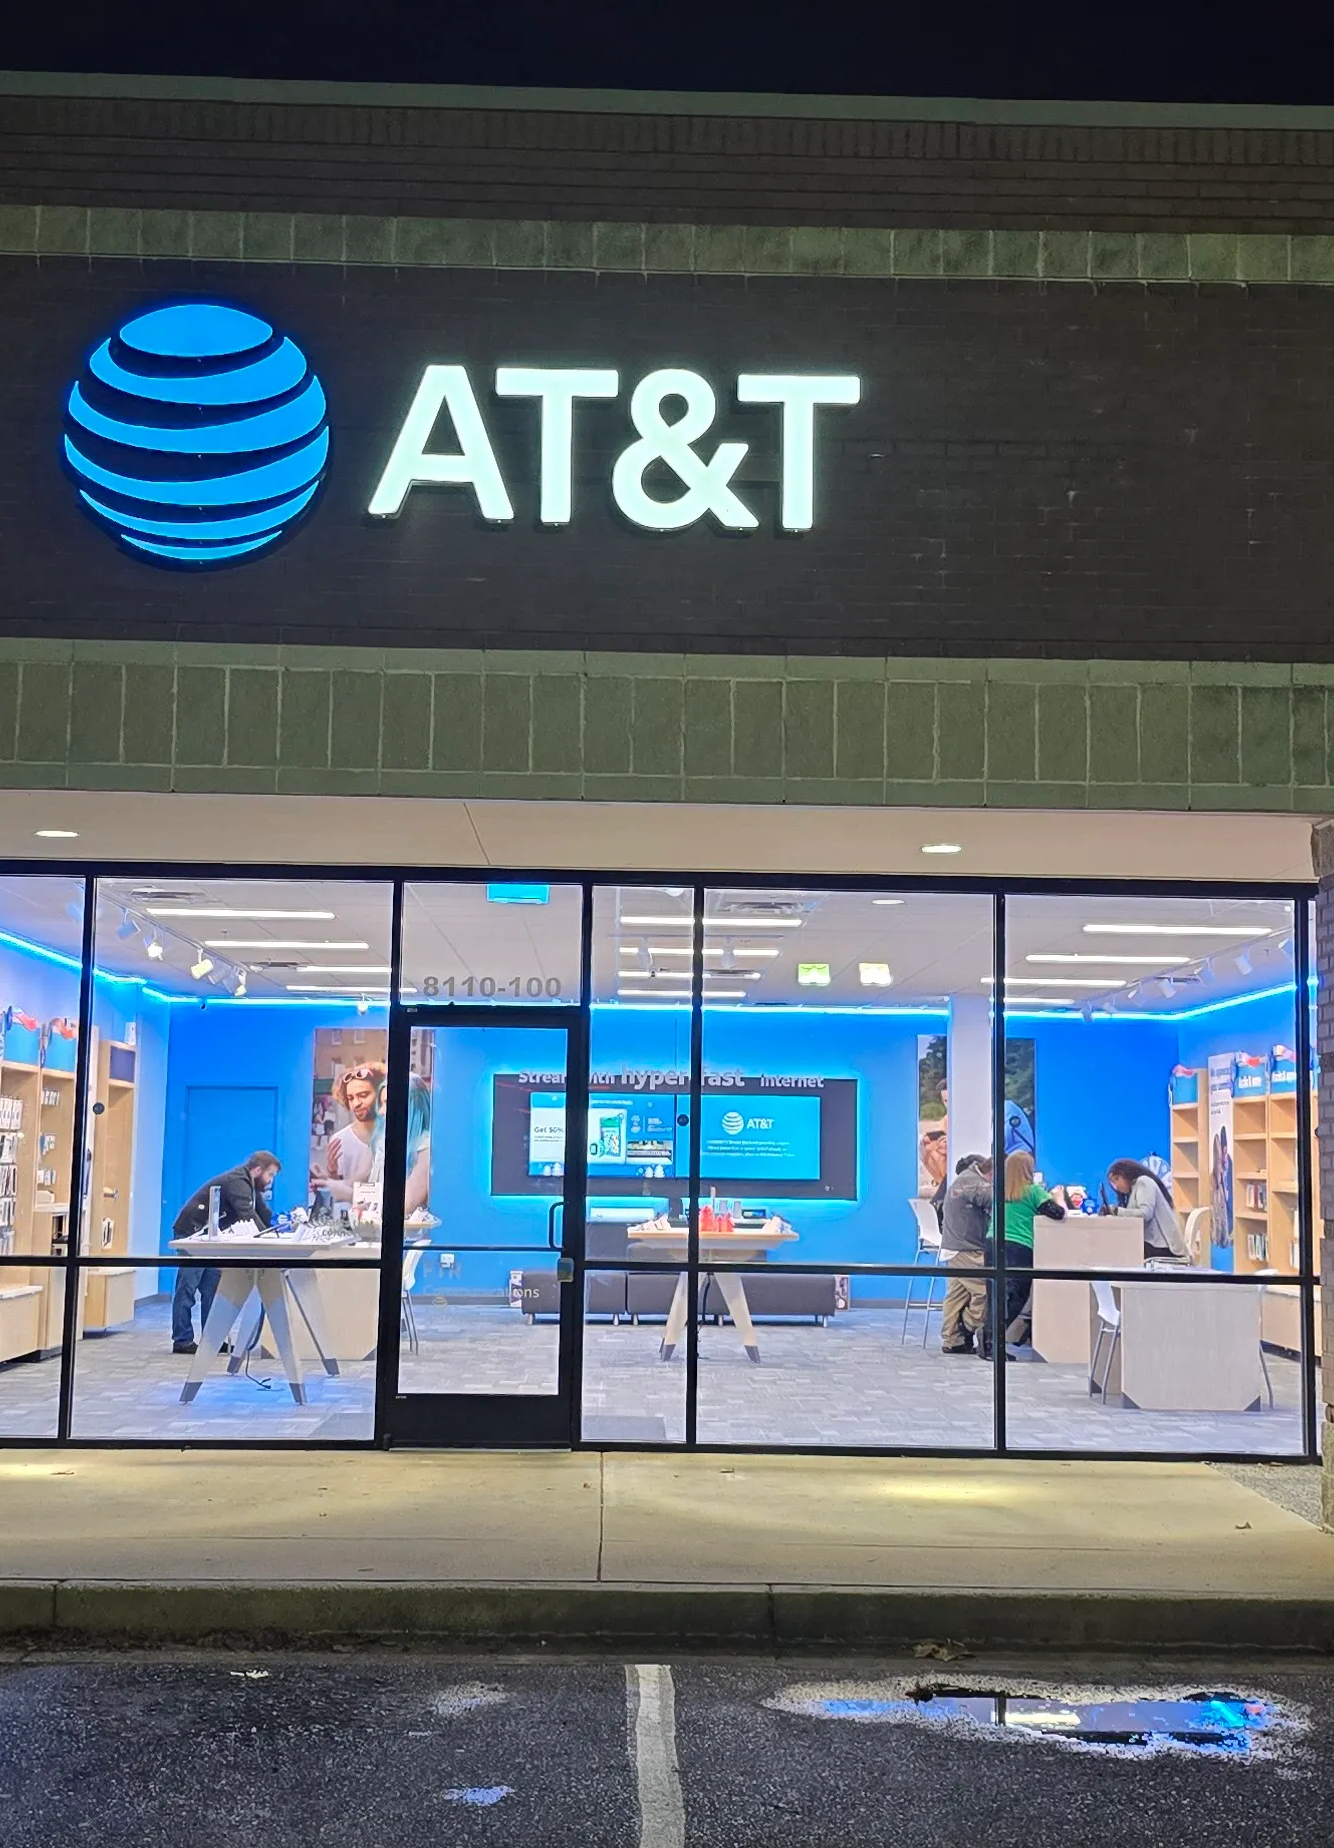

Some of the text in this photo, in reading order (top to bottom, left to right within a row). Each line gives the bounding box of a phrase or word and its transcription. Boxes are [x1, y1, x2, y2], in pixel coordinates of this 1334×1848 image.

[366, 364, 861, 533] AT&T
[423, 976, 562, 998] 8110-100
[518, 1070, 567, 1084] Strea
[589, 1070, 616, 1084] ith
[621, 1064, 691, 1091] hyper
[760, 1073, 825, 1088] internet
[746, 1118, 775, 1130] AT&T
